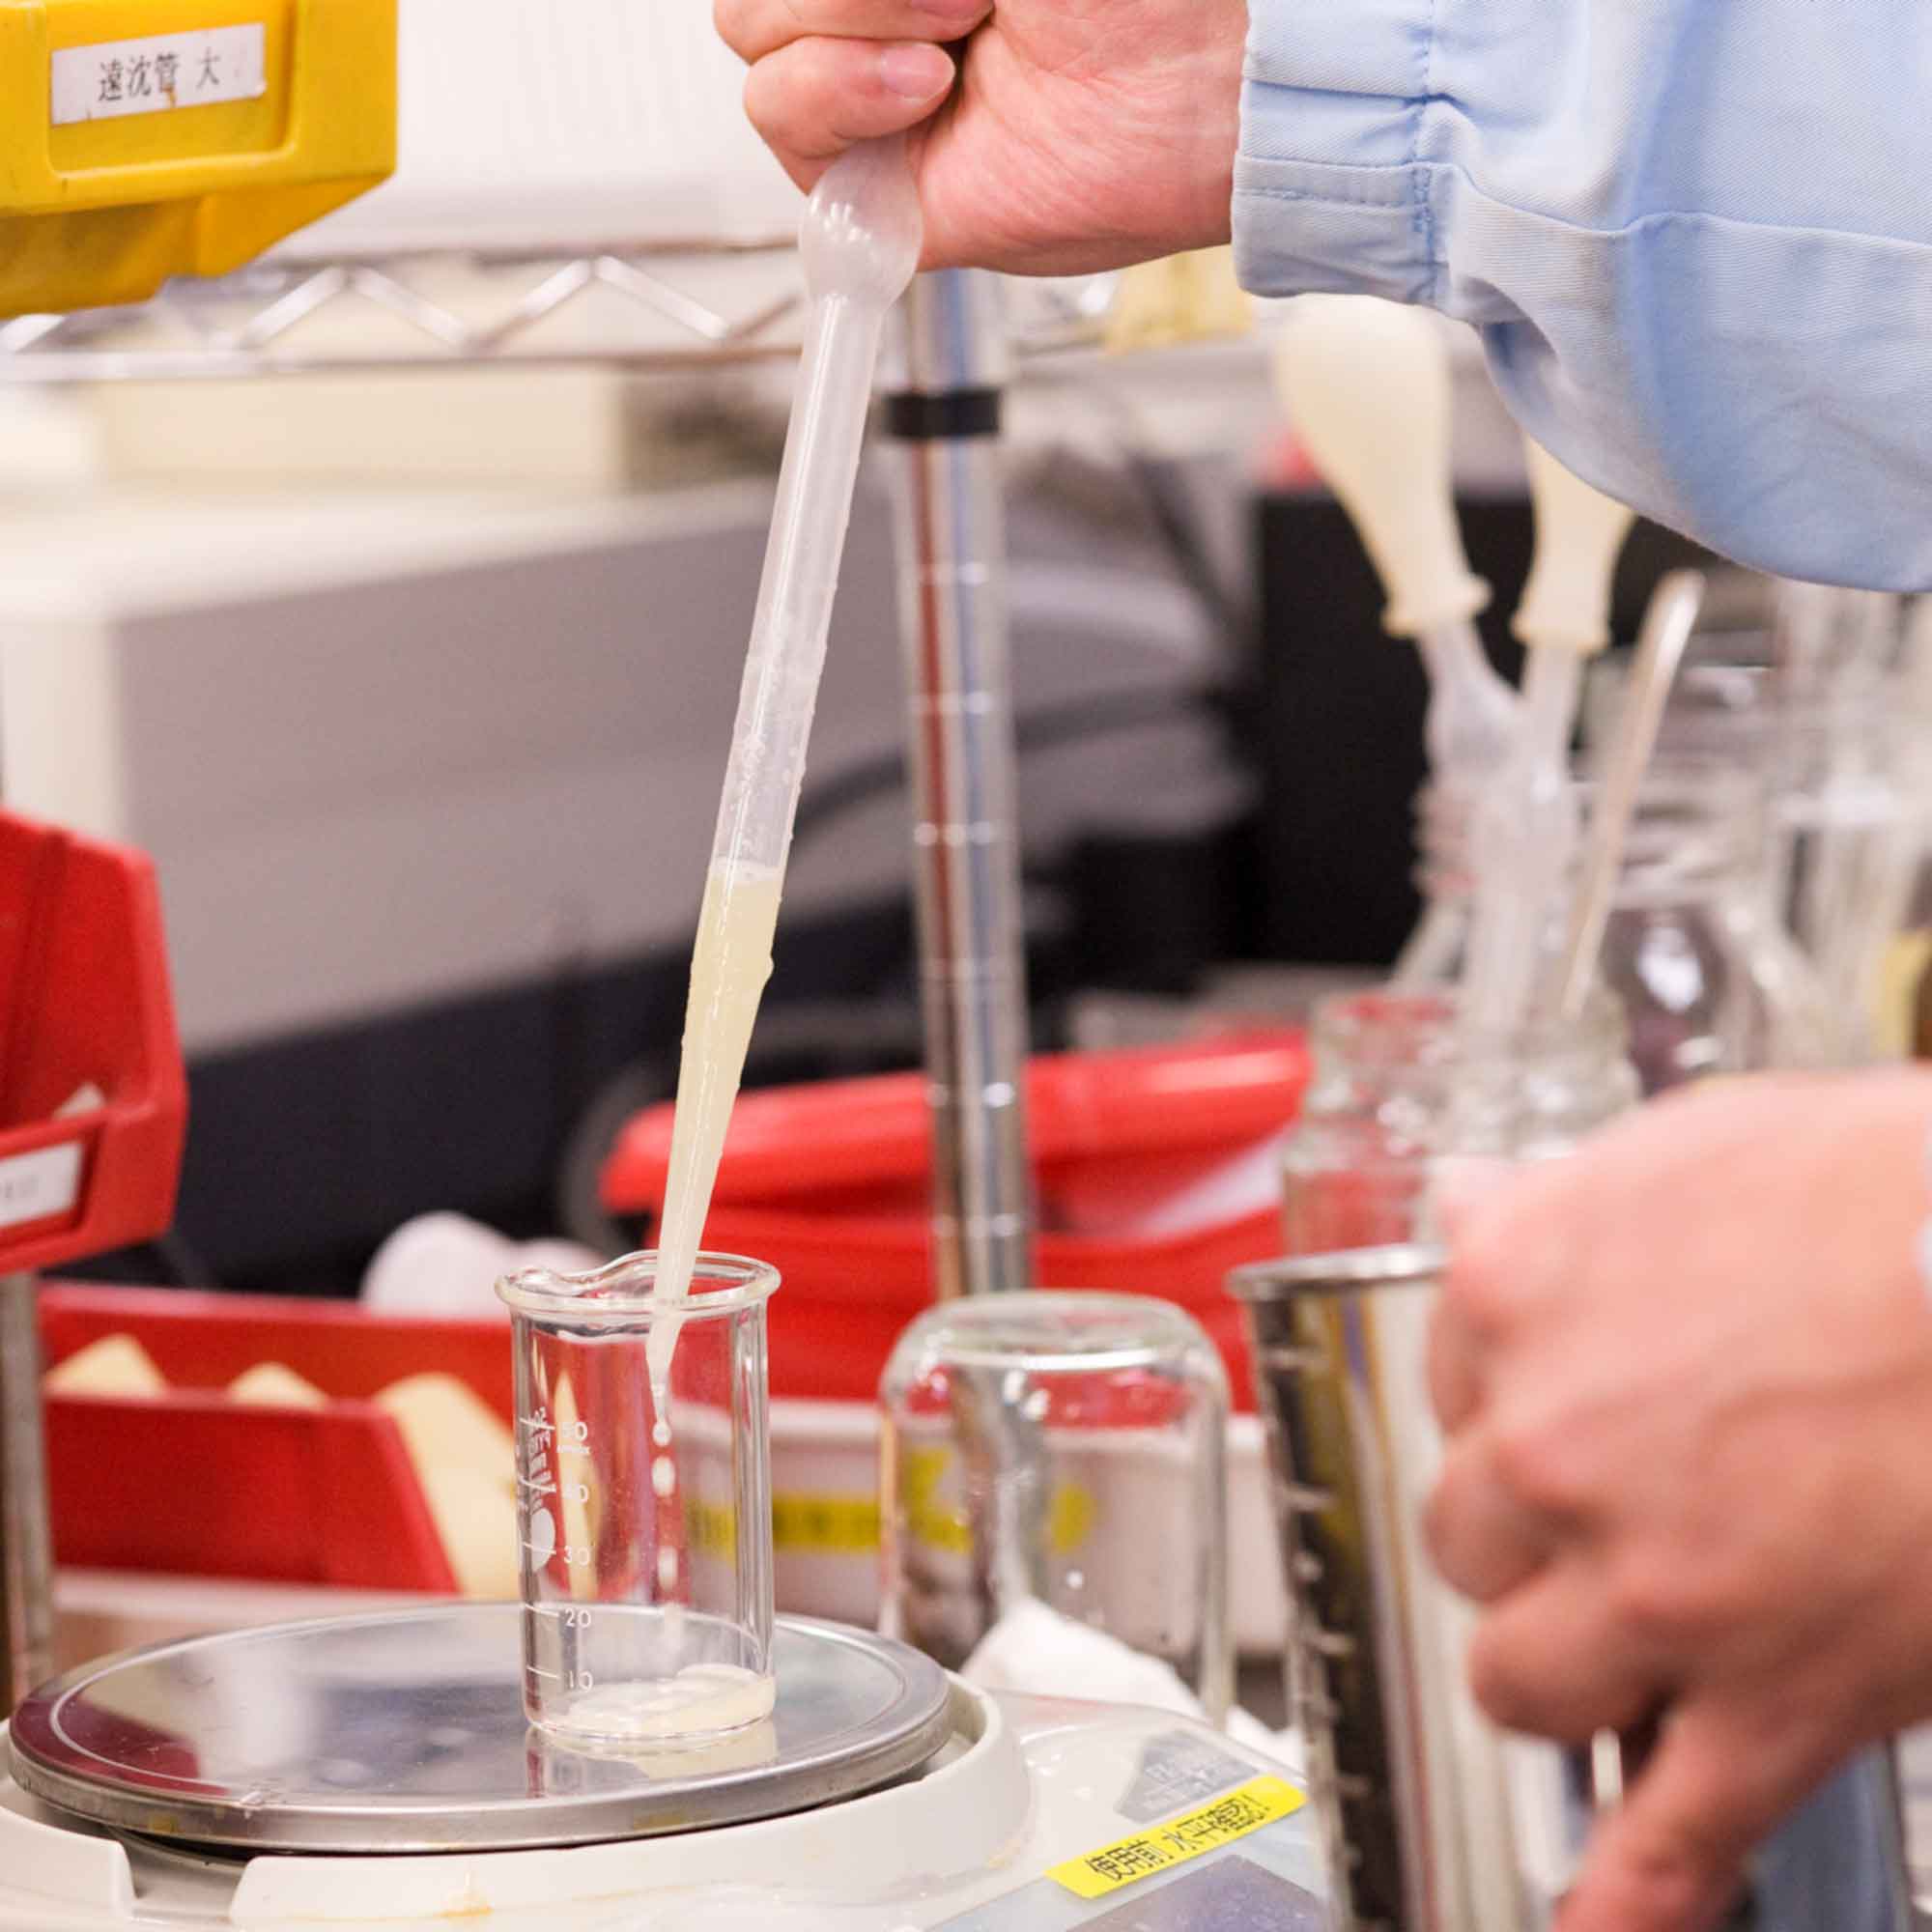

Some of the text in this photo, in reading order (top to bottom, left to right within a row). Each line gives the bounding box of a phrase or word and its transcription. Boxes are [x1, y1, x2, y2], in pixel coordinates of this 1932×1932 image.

[196, 47, 221, 91] 大
[564, 1546, 590, 1567] 30
[565, 1607, 591, 1629] 20
[569, 1670, 593, 1690] 10
[1086, 1838, 1175, 1881] 使用前
